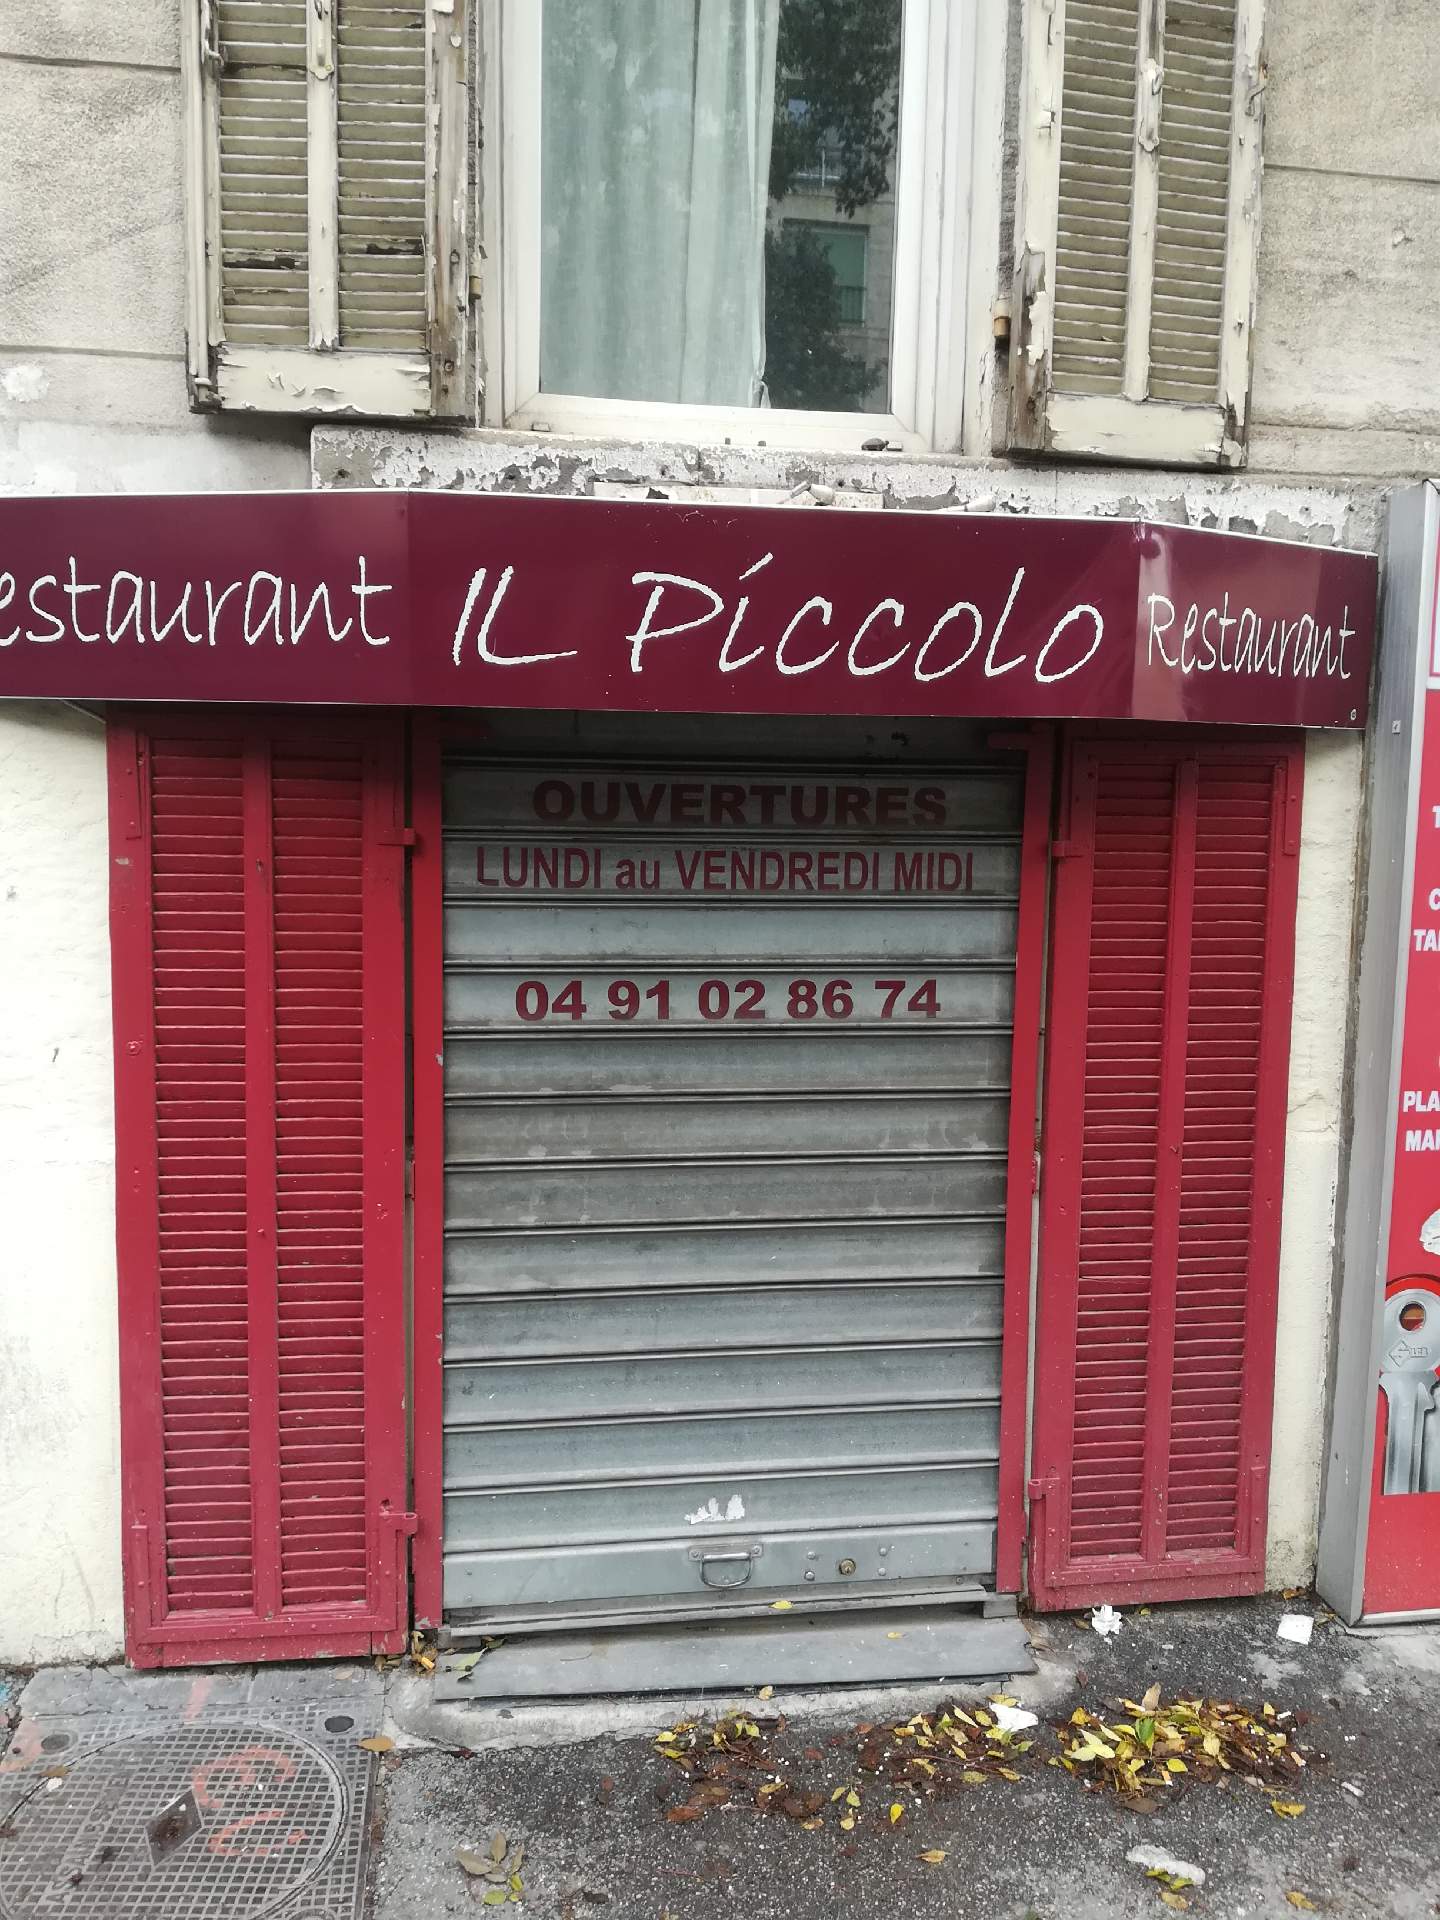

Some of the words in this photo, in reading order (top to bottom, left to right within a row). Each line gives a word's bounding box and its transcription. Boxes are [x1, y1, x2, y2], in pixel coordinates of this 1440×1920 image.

[0, 556, 392, 646] estaurant
[452, 566, 577, 666] IL
[1146, 590, 1356, 680] Restaurant
[532, 779, 948, 827] OUVERTURES
[476, 846, 601, 890] LUNDI
[615, 858, 661, 890] au
[675, 848, 880, 892] VENDREDI
[894, 850, 974, 892] MIDI
[1413, 928, 1440, 952] TA
[515, 978, 588, 1022] 04
[607, 979, 670, 1021] 91
[697, 979, 766, 1021] 02
[786, 979, 854, 1021] 86
[873, 978, 941, 1020] 74
[1405, 1128, 1440, 1152] MA
